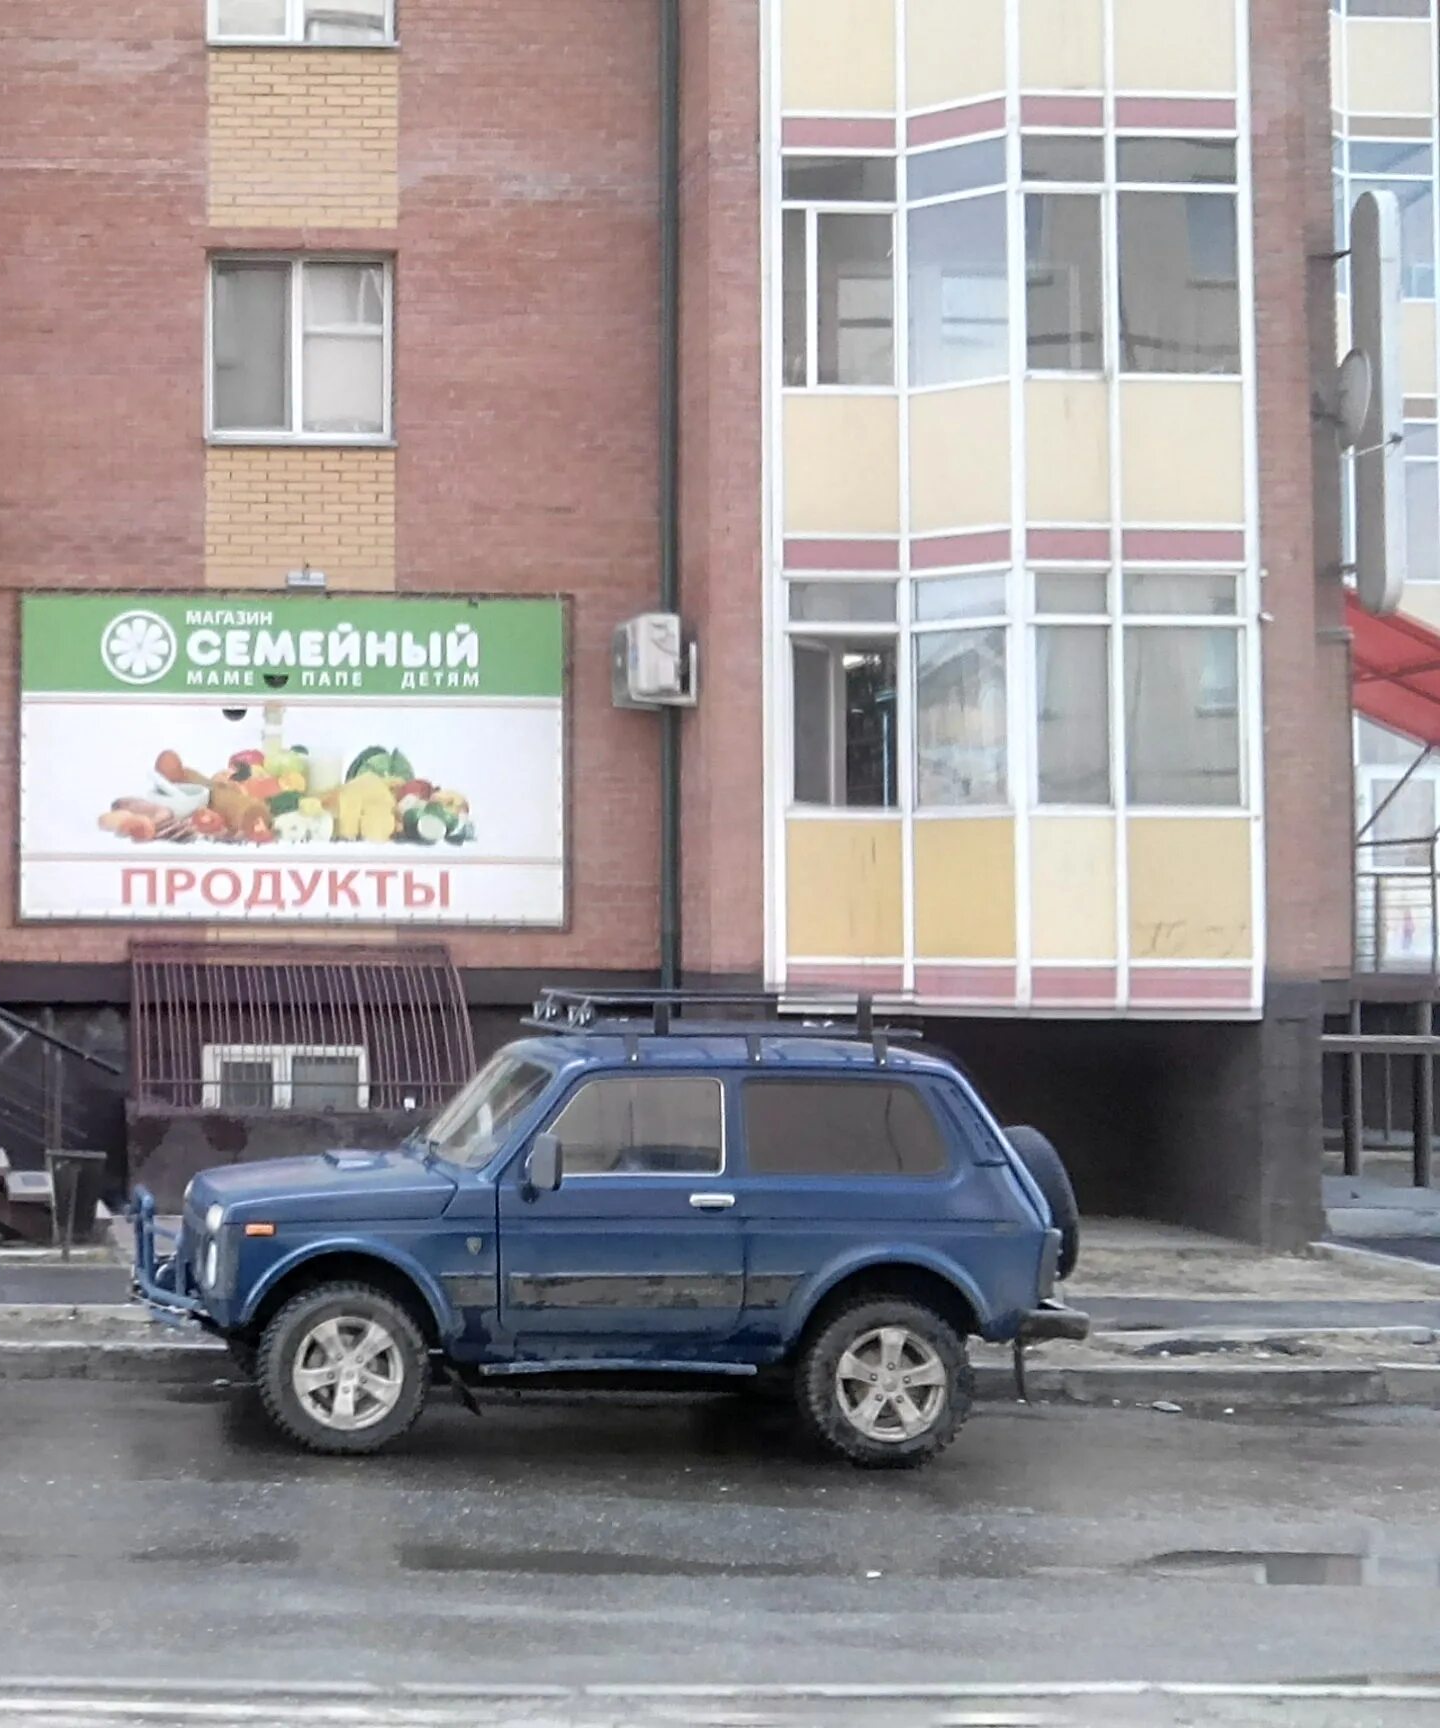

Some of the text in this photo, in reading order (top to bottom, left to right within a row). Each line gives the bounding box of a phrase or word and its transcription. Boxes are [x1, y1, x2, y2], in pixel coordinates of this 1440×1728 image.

[185, 610, 273, 626] МАГАЗИН
[186, 622, 479, 668] СЕМЕЙНЫЙ
[187, 670, 480, 689] МАМЕ ПАПЕ ДЕТЯМ
[121, 868, 451, 910] ПРОДУКТЫ
